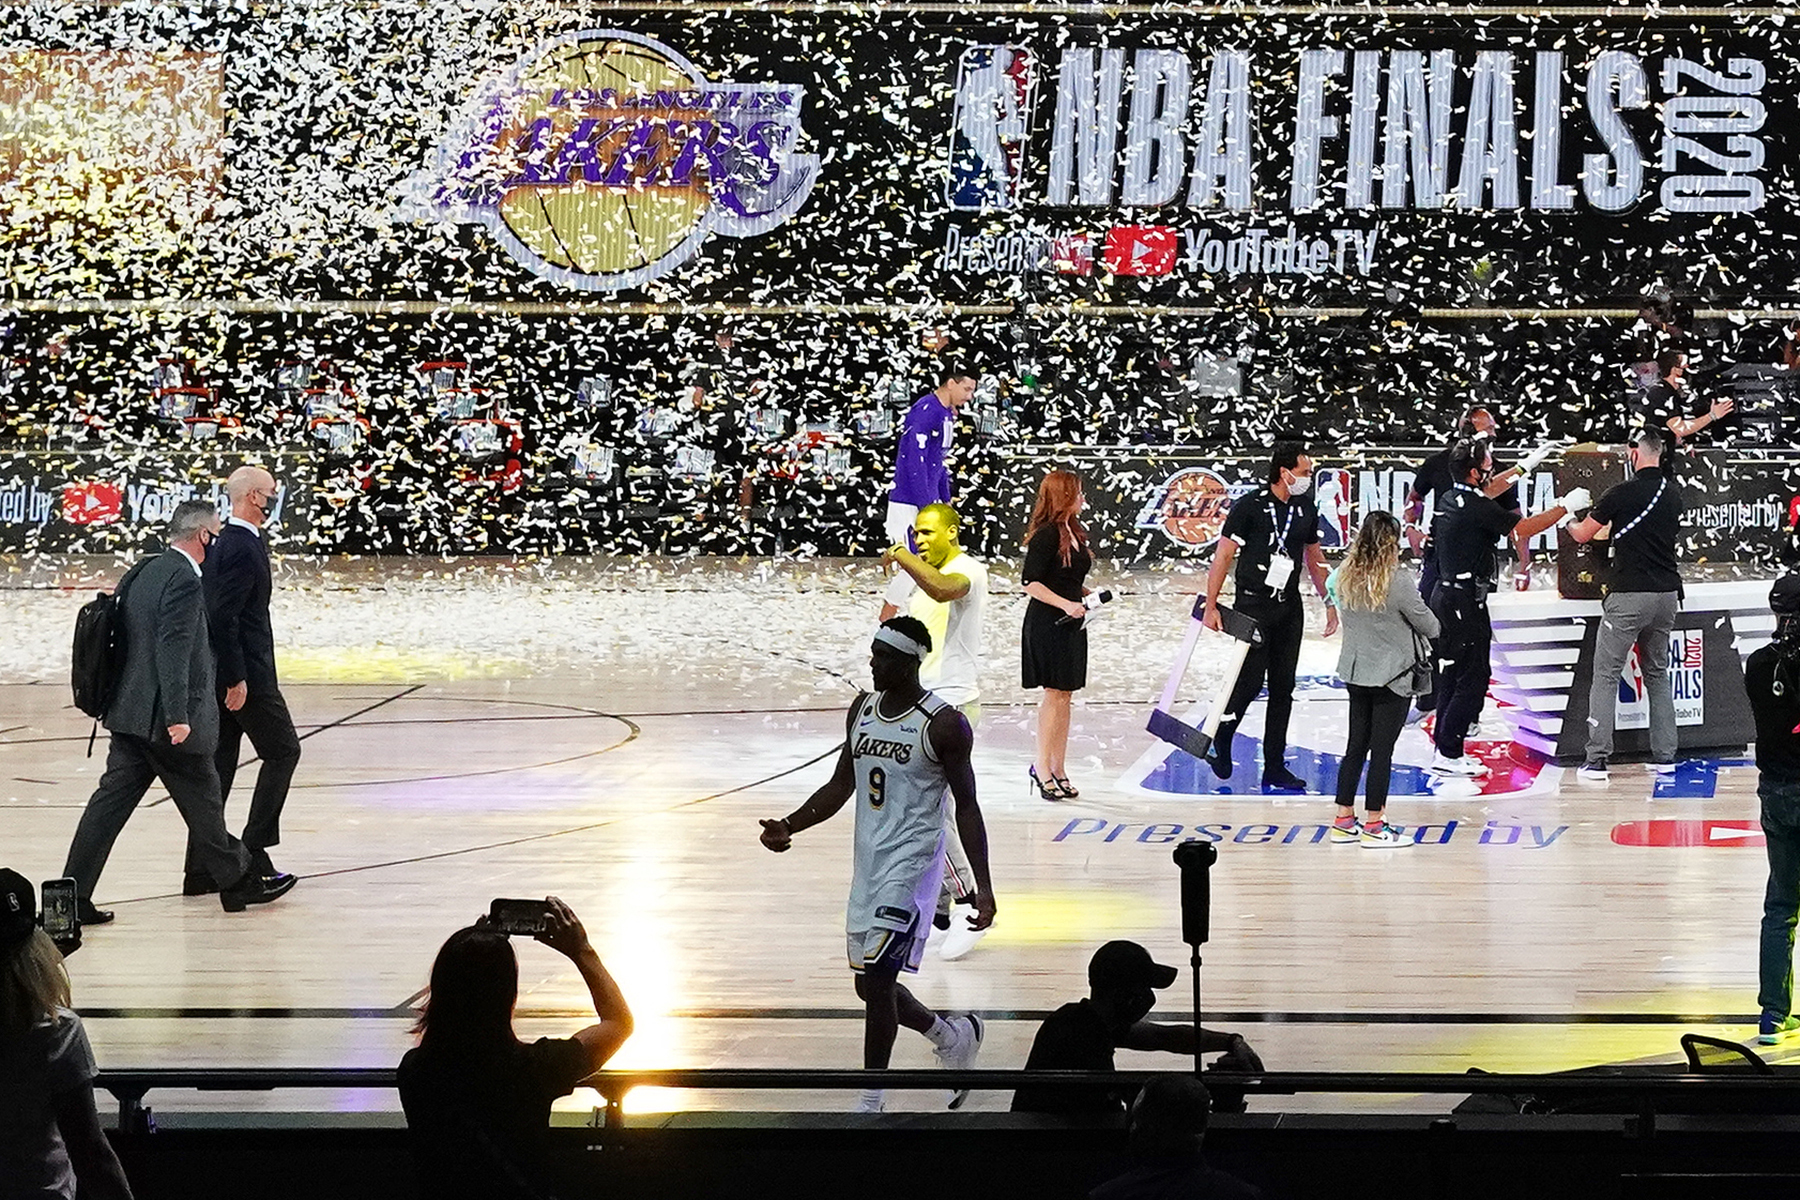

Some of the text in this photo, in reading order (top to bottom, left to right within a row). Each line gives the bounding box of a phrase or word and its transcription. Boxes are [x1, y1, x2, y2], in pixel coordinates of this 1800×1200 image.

[1046, 47, 1768, 213] NBA FINALS 2020
[29, 484, 52, 527] by
[852, 732, 914, 765] LAKERS
[869, 766, 886, 811] 9
[1052, 817, 1460, 845] Presend
[1478, 819, 1571, 850] by
